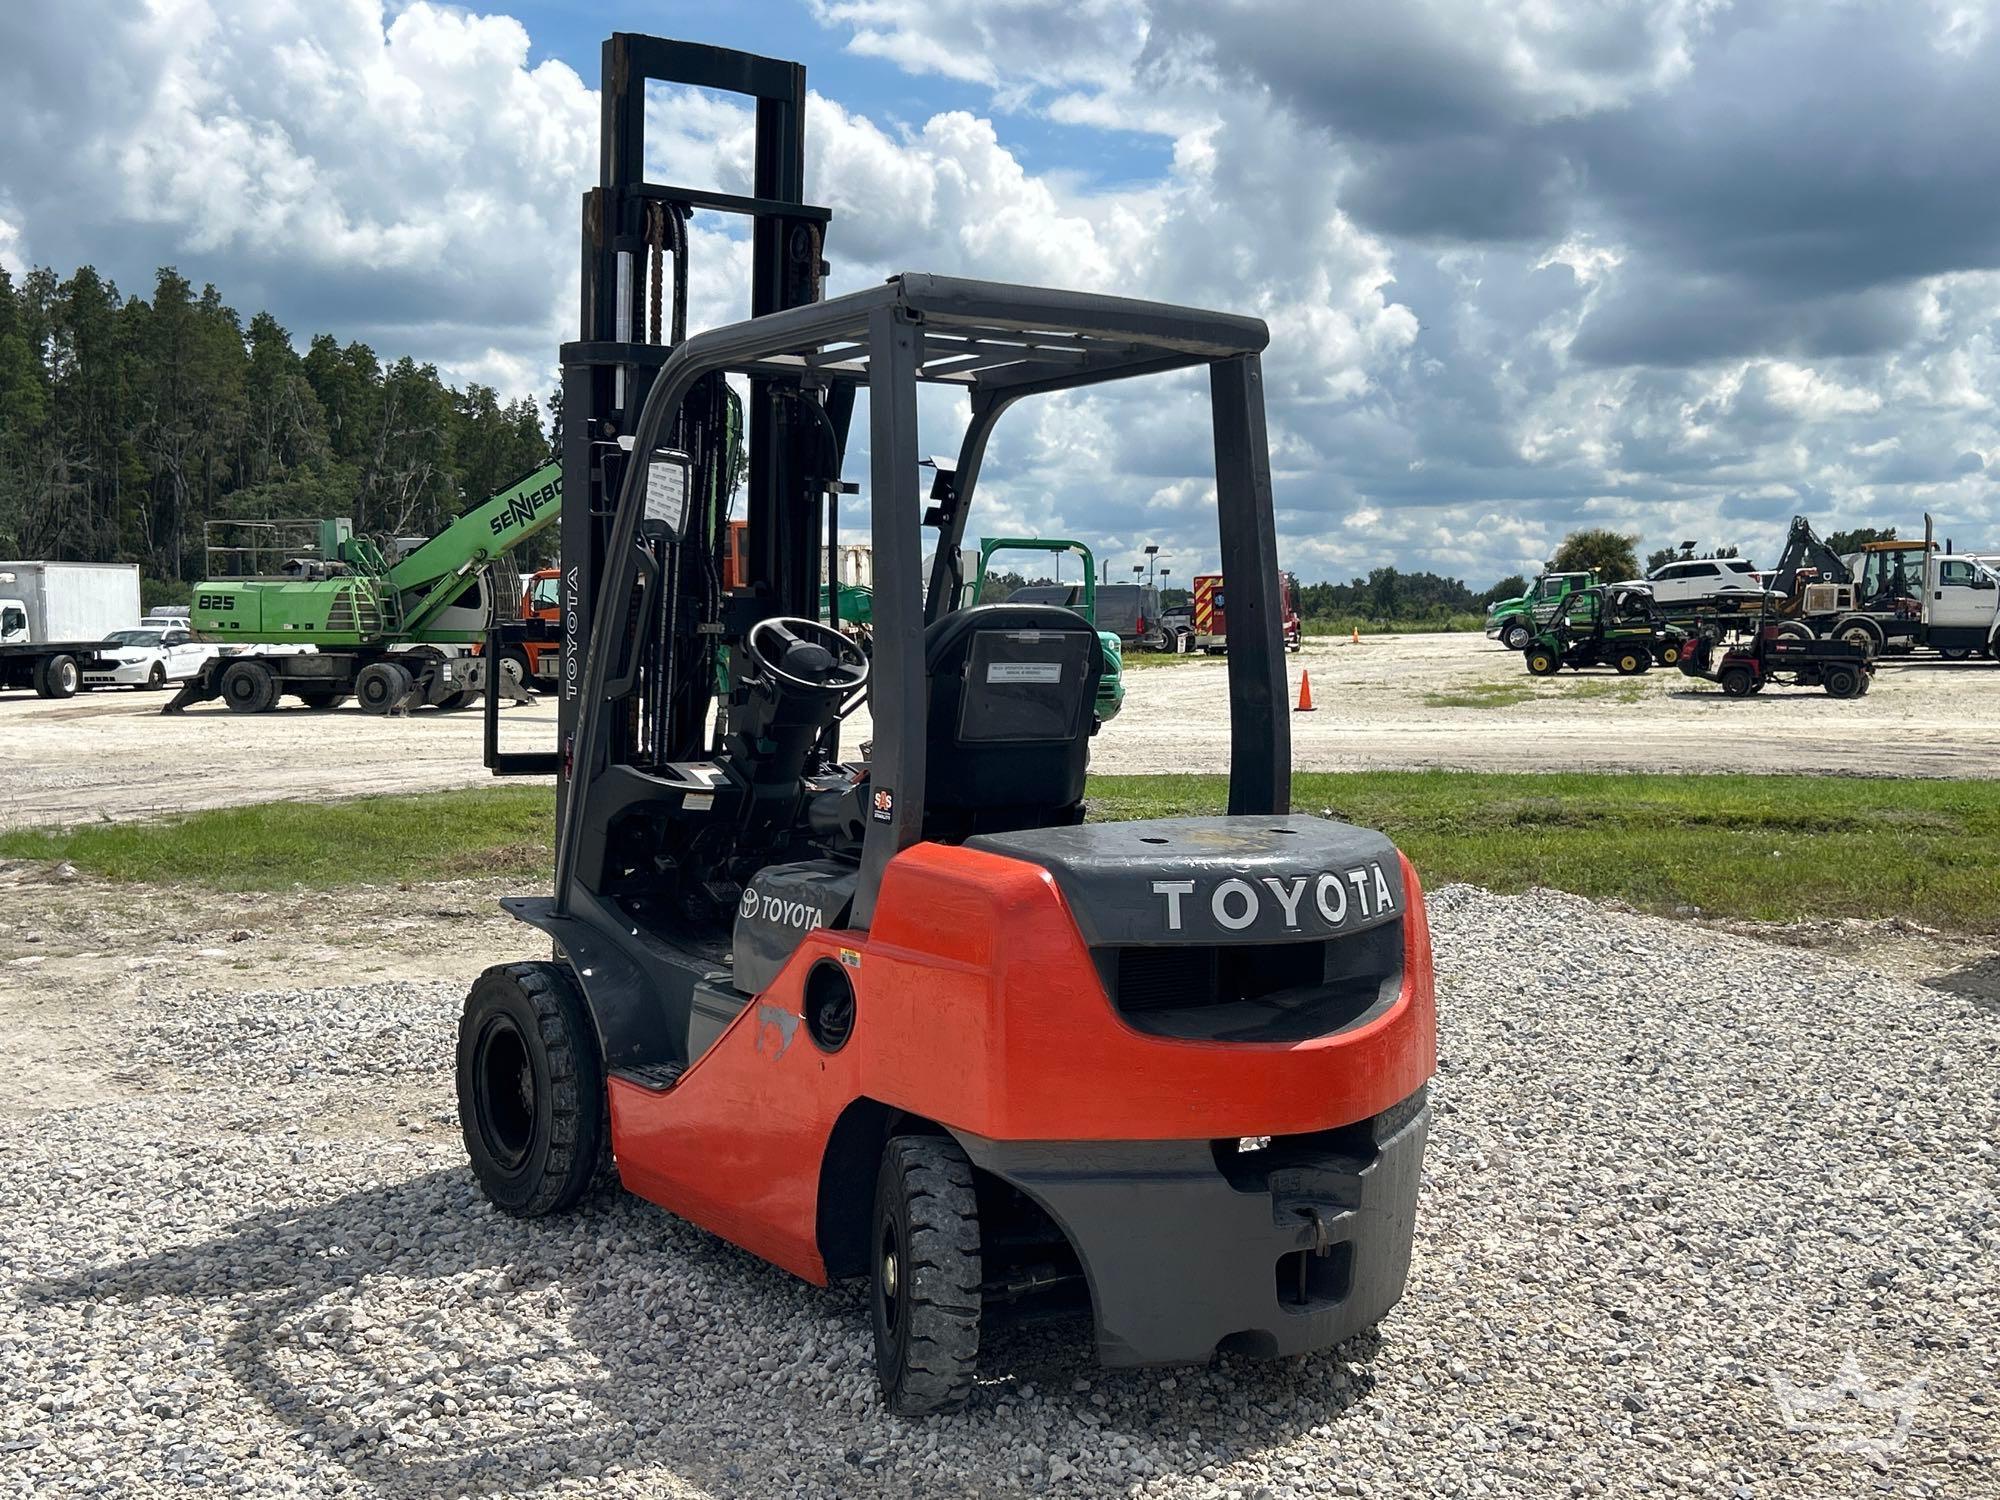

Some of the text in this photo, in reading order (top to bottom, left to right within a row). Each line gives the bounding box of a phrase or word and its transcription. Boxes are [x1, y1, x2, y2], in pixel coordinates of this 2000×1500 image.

[199, 595, 235, 610] 825
[566, 566, 579, 700] TOYOTA
[762, 895, 822, 931] TOYOTA
[1152, 862, 1396, 931] TOYOTA
